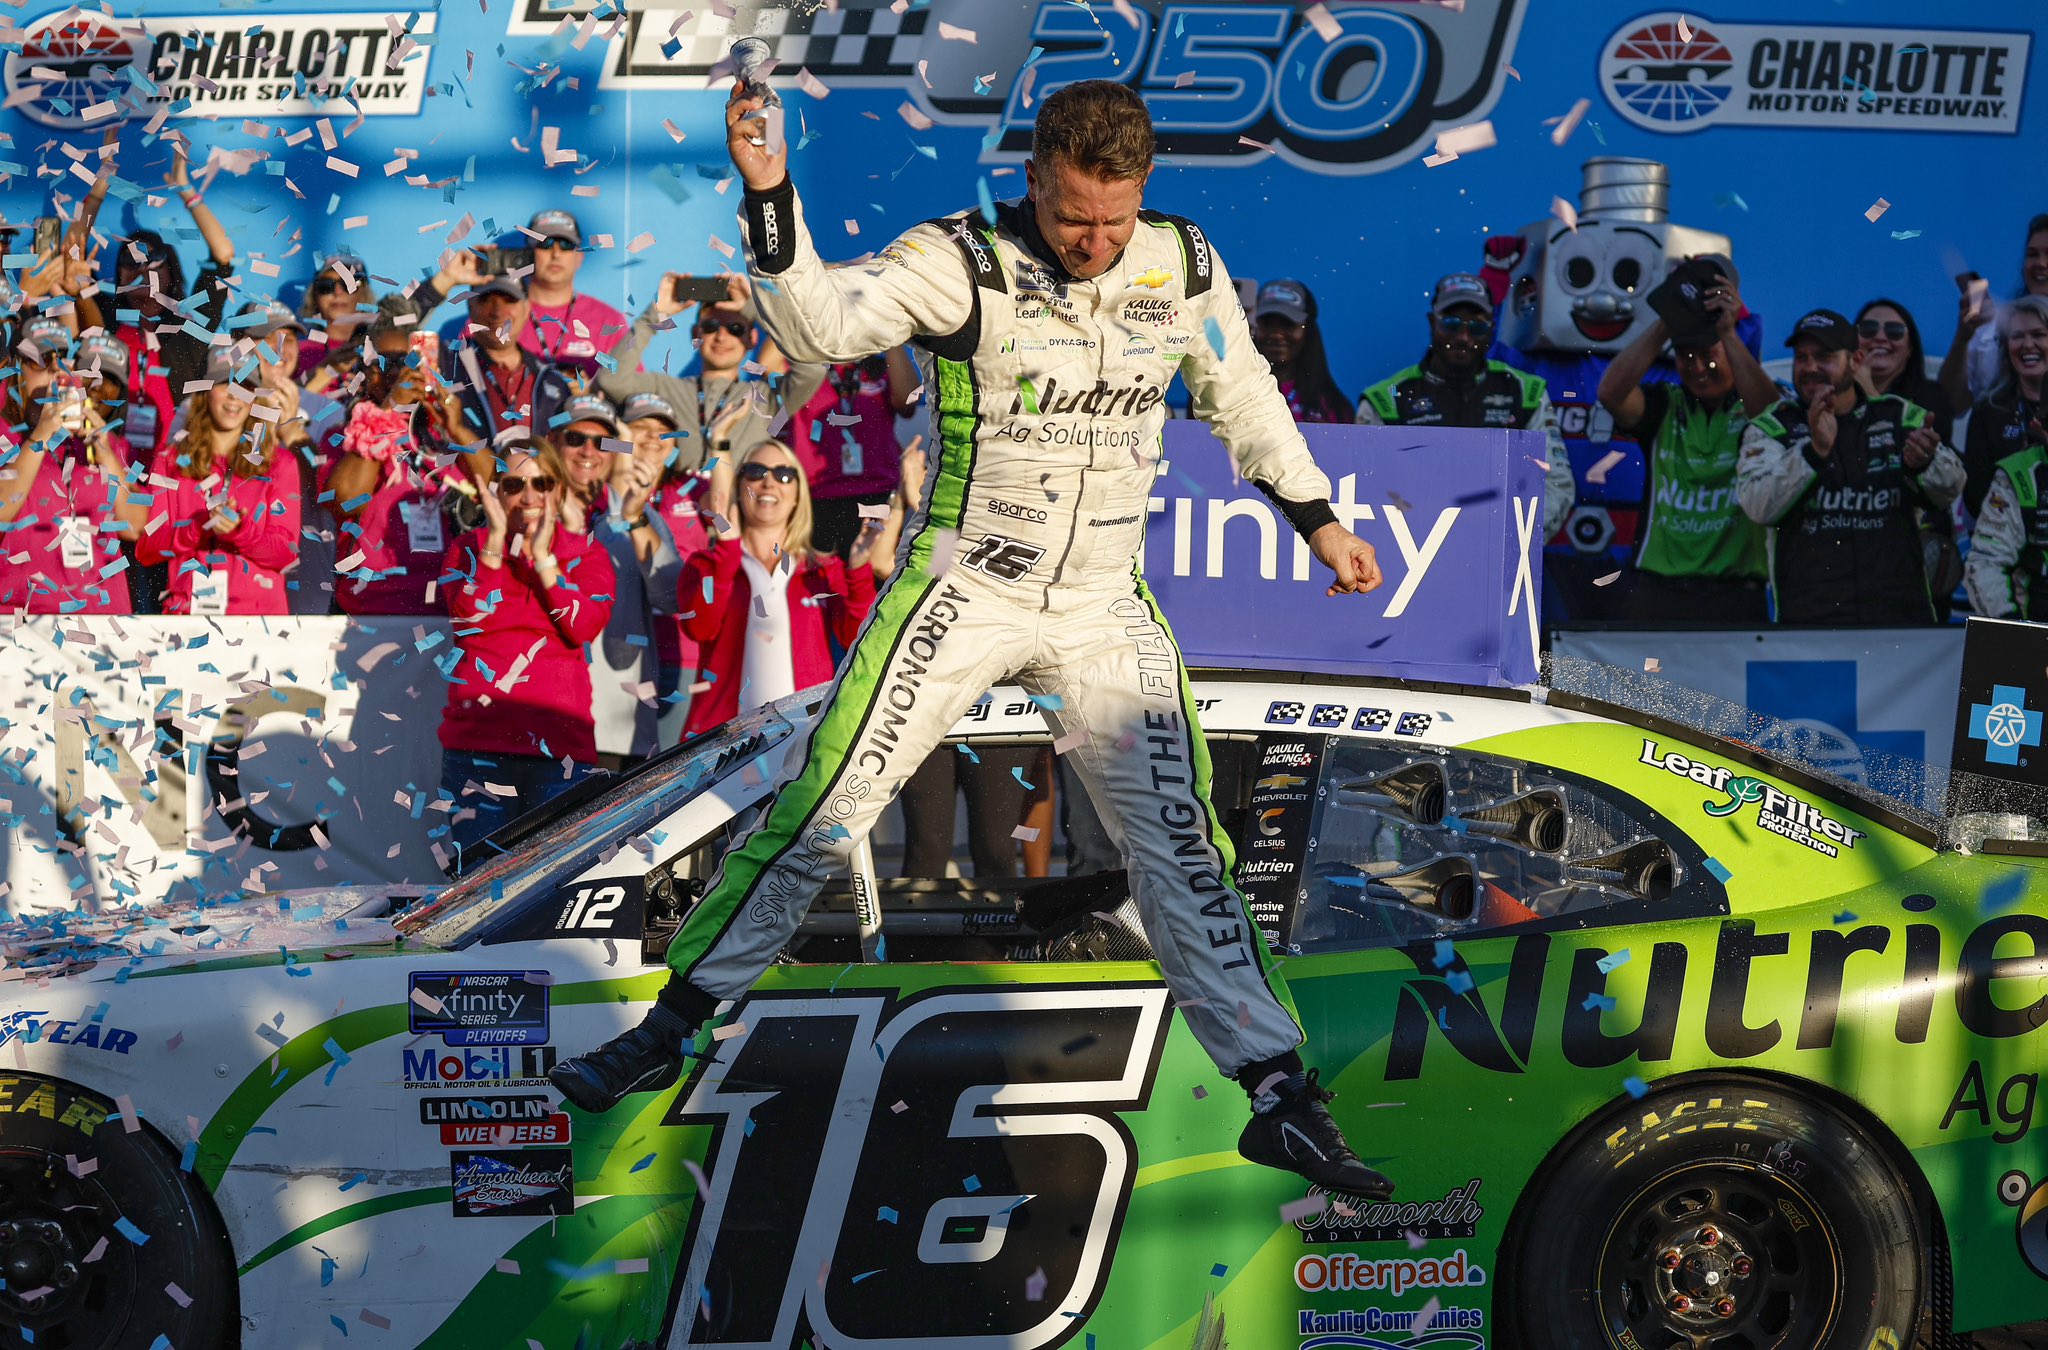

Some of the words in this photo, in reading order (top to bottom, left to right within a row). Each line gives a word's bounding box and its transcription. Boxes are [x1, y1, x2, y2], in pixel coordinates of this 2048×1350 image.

[150, 29, 410, 80] CHARLOTTE
[1749, 38, 2009, 96] CHARLOTTE
[992, 2, 1430, 142] 250
[147, 83, 246, 103] MOTOR
[1748, 93, 1848, 112] MOTOR
[1857, 97, 2006, 119] SPEEDWAY
[763, 202, 779, 256] sparco
[952, 224, 992, 274] sparco
[1186, 224, 1210, 277] sparco
[1015, 307, 1041, 319] Leaf
[1124, 311, 1168, 322] RACING
[1125, 300, 1172, 310] KAULIG
[1049, 338, 1096, 349] DYNAGRO
[1009, 374, 1164, 416] Nutrie
[994, 421, 1031, 443] Ag
[1037, 422, 1140, 447] Solutions
[988, 499, 1047, 524] sparco
[1821, 513, 1885, 530] Solutions
[960, 534, 1047, 583] 16
[1107, 597, 1174, 699] FIELD
[859, 583, 971, 776] AGRONOMIC
[1145, 708, 1186, 791] THE
[1262, 754, 1302, 767] RACING
[1266, 743, 1306, 756] KAULIG
[1252, 793, 1309, 803] CHEVROLET
[1639, 740, 1733, 792] Leaf
[1762, 786, 1866, 848] Filter
[1761, 809, 1811, 837] GUTTER
[1253, 839, 1286, 849] CELSIUS
[1758, 817, 1838, 858] PROTECTION
[1239, 858, 1295, 874] Nutrien
[854, 873, 869, 926] Nutrien
[1160, 803, 1254, 970] LEADING
[555, 907, 571, 929] ROUND
[564, 886, 626, 929] 12
[463, 976, 509, 986] NASCAR
[1384, 896, 2048, 1083] Nutrie
[433, 987, 525, 1019] xfinity
[460, 1014, 498, 1026] SERIES
[465, 1029, 528, 1042] PLAYOFFS
[402, 1047, 510, 1081] Mobil
[404, 1081, 442, 1090] OFFICIAL
[443, 1080, 477, 1089] MOTOR
[477, 1080, 491, 1088] OIL
[494, 1079, 501, 1088] &
[502, 1078, 554, 1087] LUBRICANT
[426, 1100, 543, 1120] LINCOLN
[1939, 1061, 2038, 1143] Ag
[455, 1124, 557, 1142] WELERS
[453, 1162, 568, 1187] Arrowhead
[658, 984, 1172, 1350] 16
[473, 1183, 523, 1201] Brass
[1782, 1202, 1805, 1226] AERO
[1305, 1226, 1474, 1243] ADVISORS
[1298, 1251, 1466, 1294] Offerpad
[1300, 1307, 1484, 1334] KauligComanies
